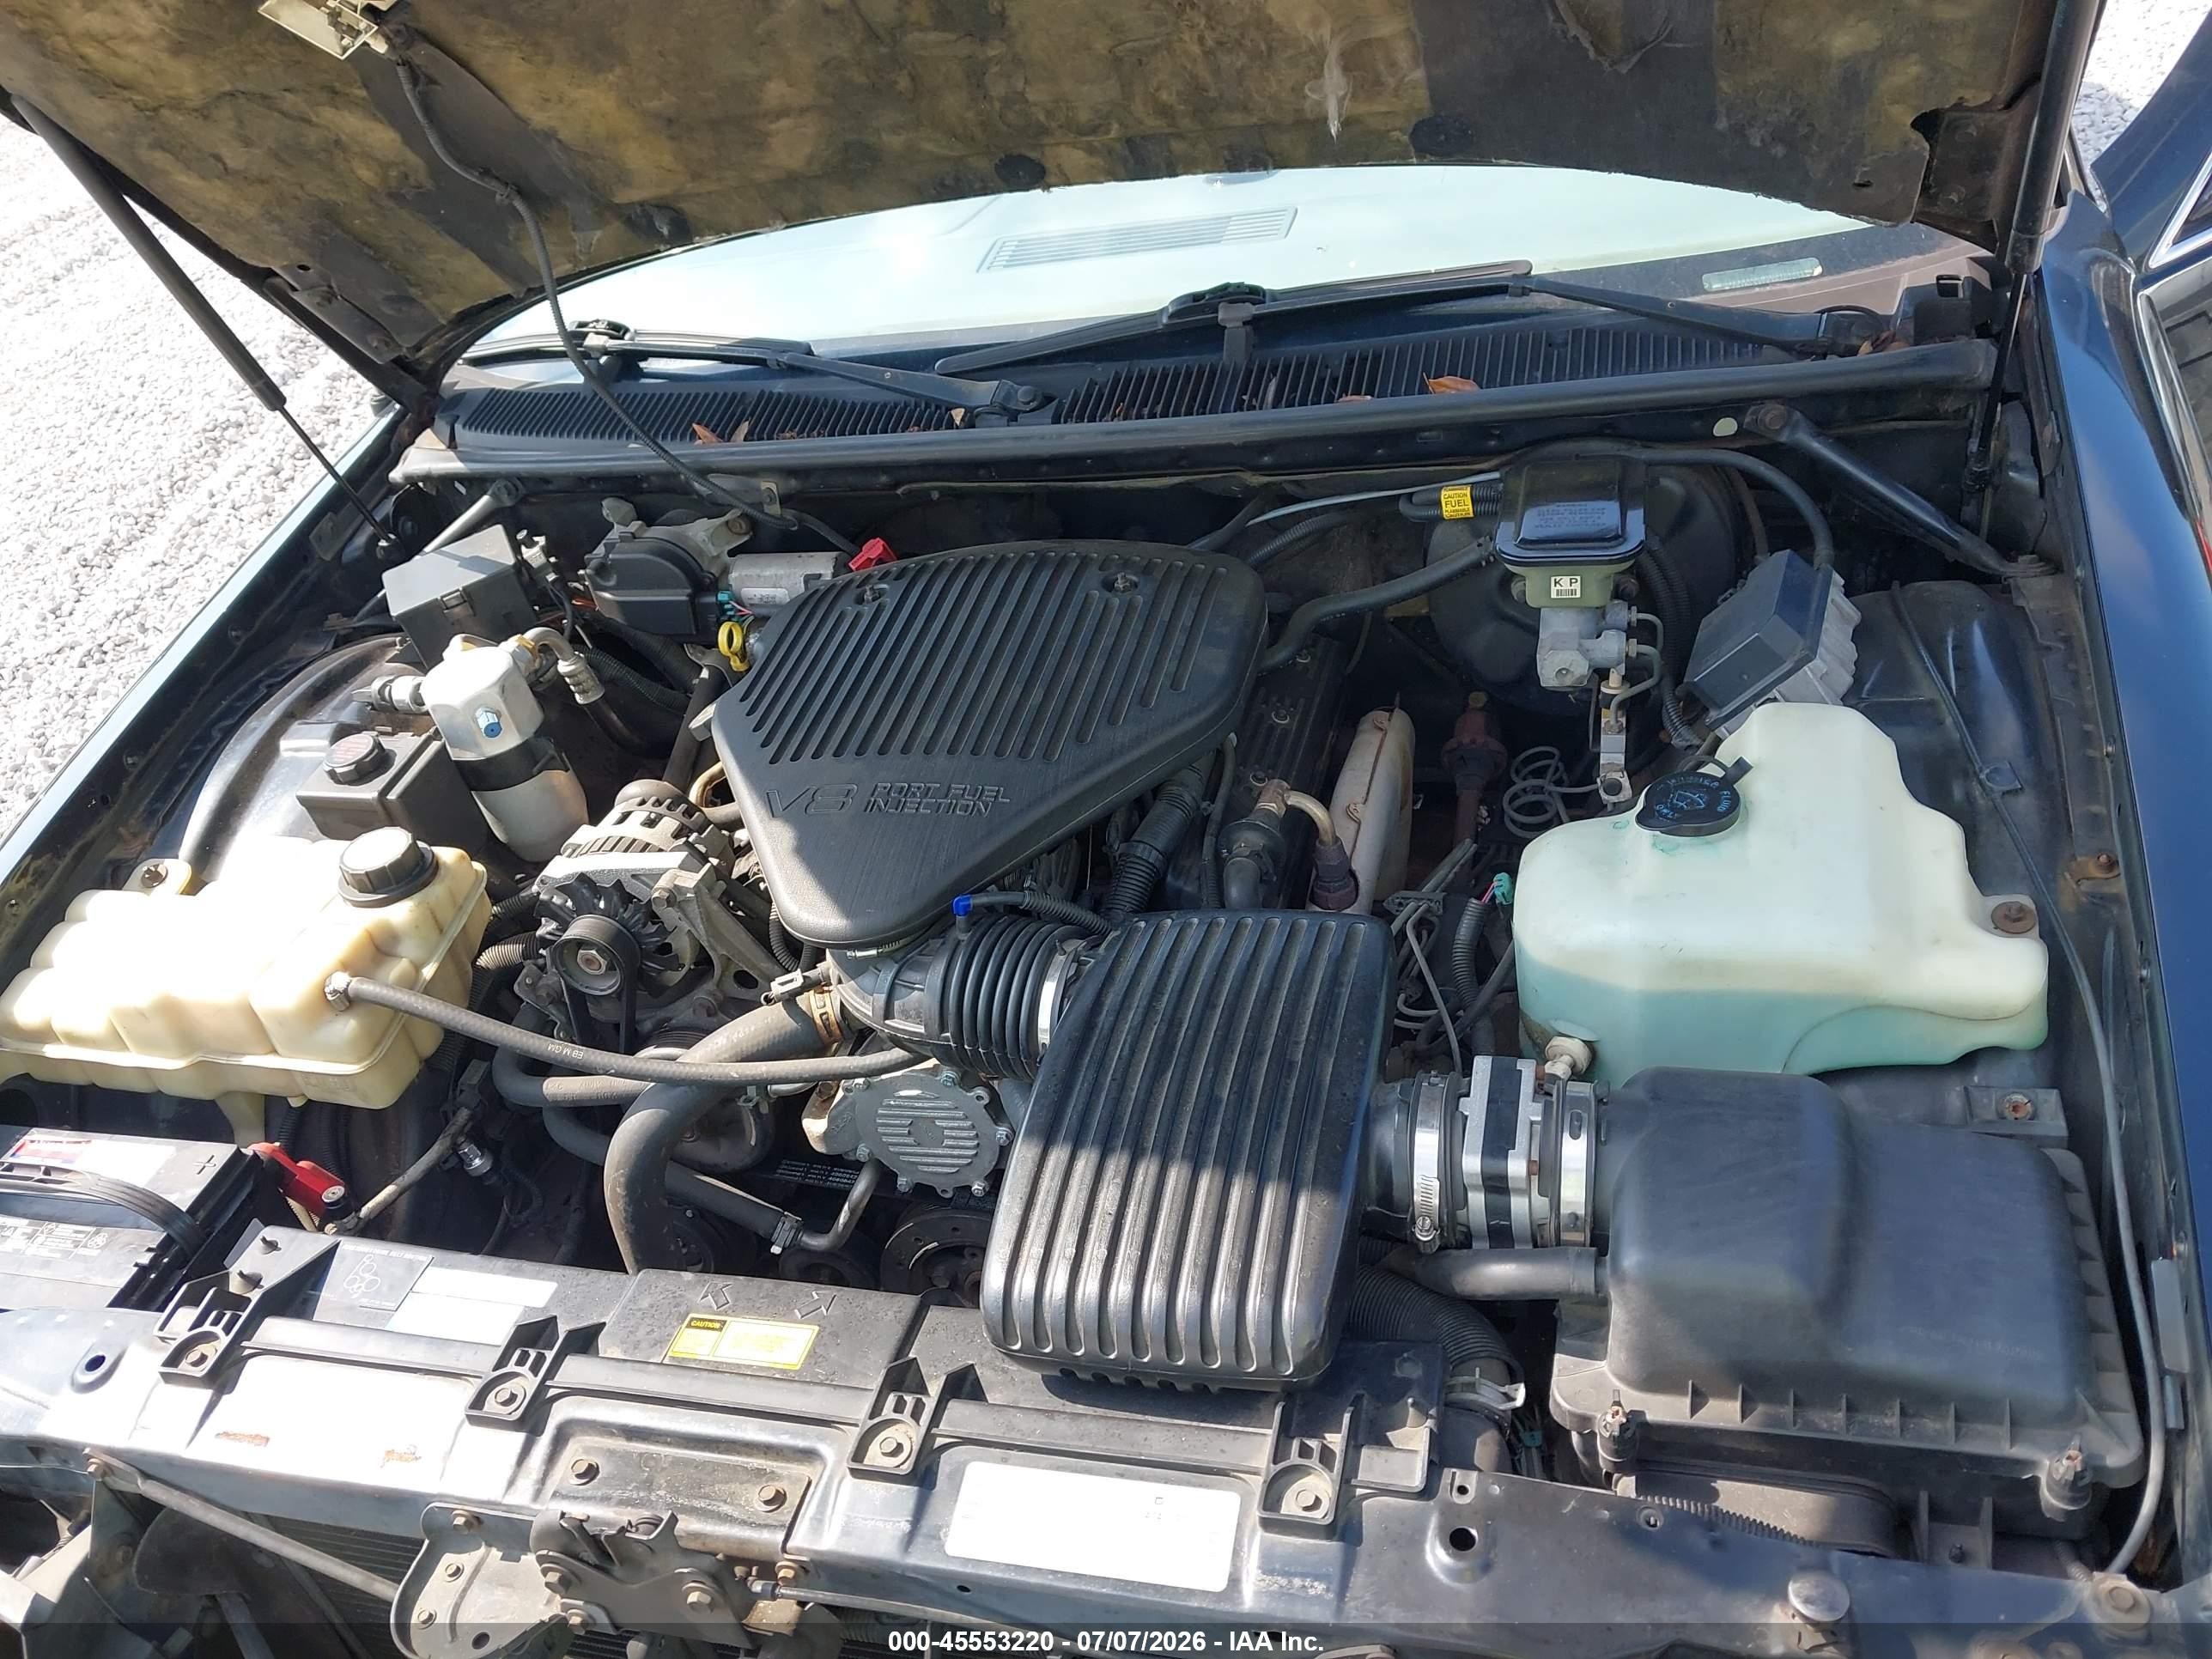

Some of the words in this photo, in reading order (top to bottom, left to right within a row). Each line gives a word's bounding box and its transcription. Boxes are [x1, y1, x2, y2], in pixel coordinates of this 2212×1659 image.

[1444, 499, 1469, 508] FUEL
[766, 783, 858, 817] V8
[871, 782, 941, 799] PORT
[945, 783, 1010, 803] FUEL
[864, 798, 994, 817] INJECTION
[690, 1320, 720, 1329] CAUTION
